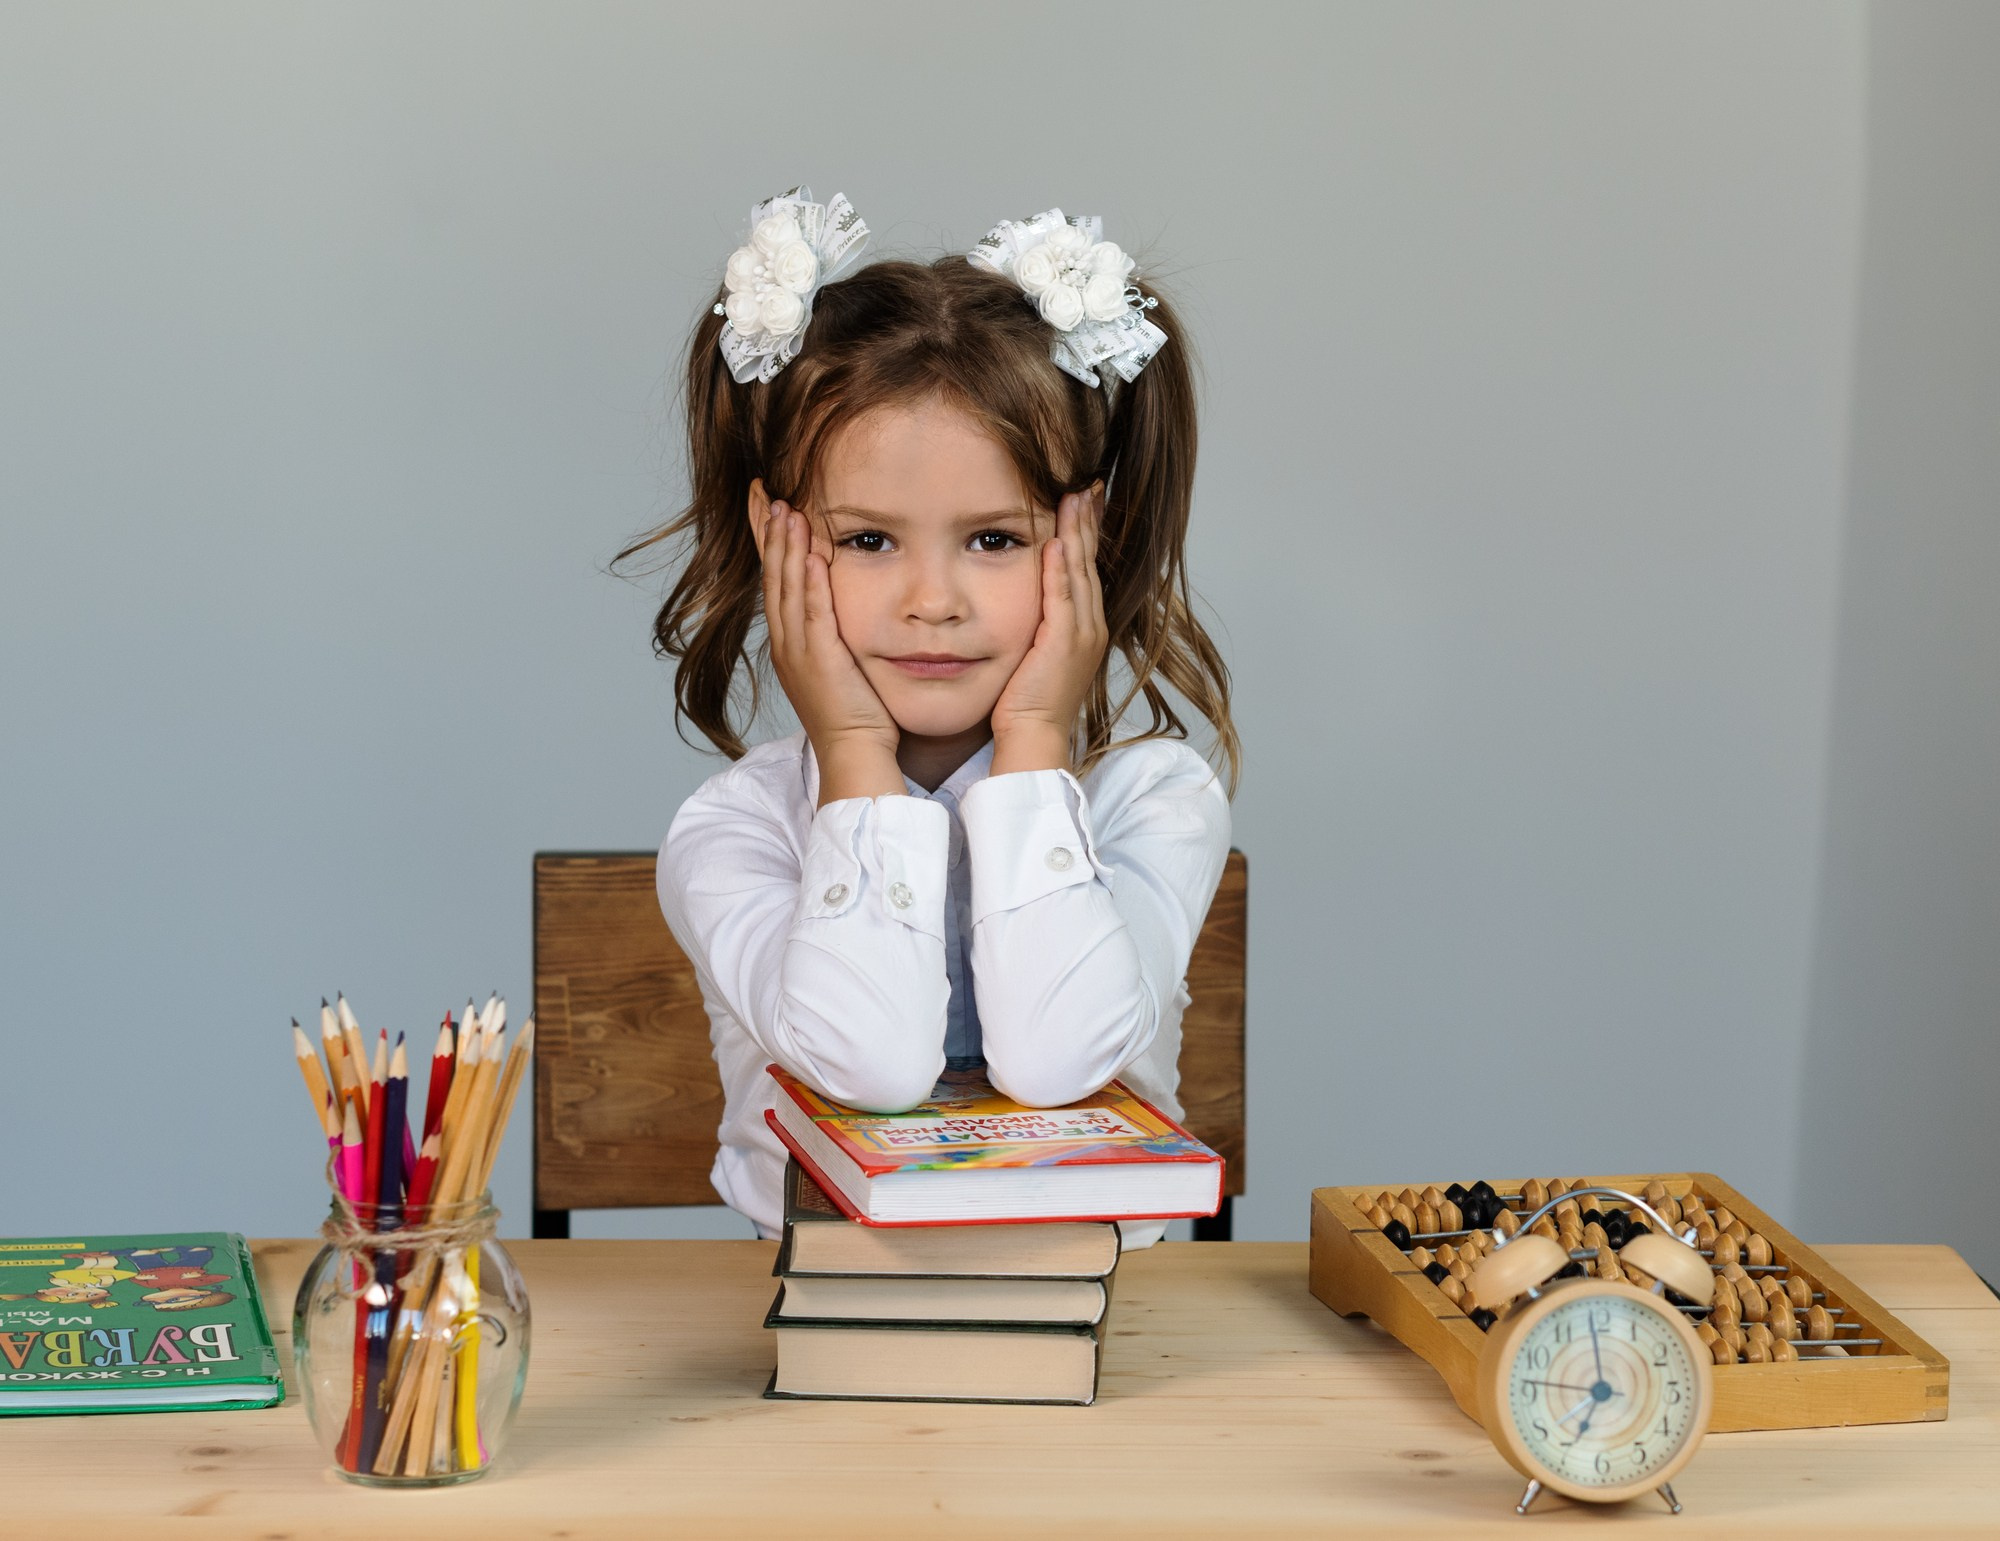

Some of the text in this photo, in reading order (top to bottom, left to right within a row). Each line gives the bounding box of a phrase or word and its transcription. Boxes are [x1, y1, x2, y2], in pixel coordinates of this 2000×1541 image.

[881, 1116, 1110, 1138] ДЛЯ НАЧАЛЬНОЙ
[943, 1115, 1046, 1127] ШКОЛЫ
[887, 1125, 1133, 1145] ХРЕСТОМАТИЯ
[1554, 1321, 1573, 1344] 11
[1630, 1321, 1637, 1343] 1
[1526, 1344, 1551, 1371] 10
[1652, 1341, 1668, 1367] 2
[131, 1369, 167, 1377] С.
[176, 1367, 210, 1376] Н.
[1520, 1379, 1538, 1402] 9
[1662, 1380, 1681, 1406] 3
[1532, 1418, 1549, 1441] 8
[1653, 1414, 1672, 1438] 4
[1594, 1451, 1611, 1475] 6
[1630, 1441, 1647, 1466] 5
